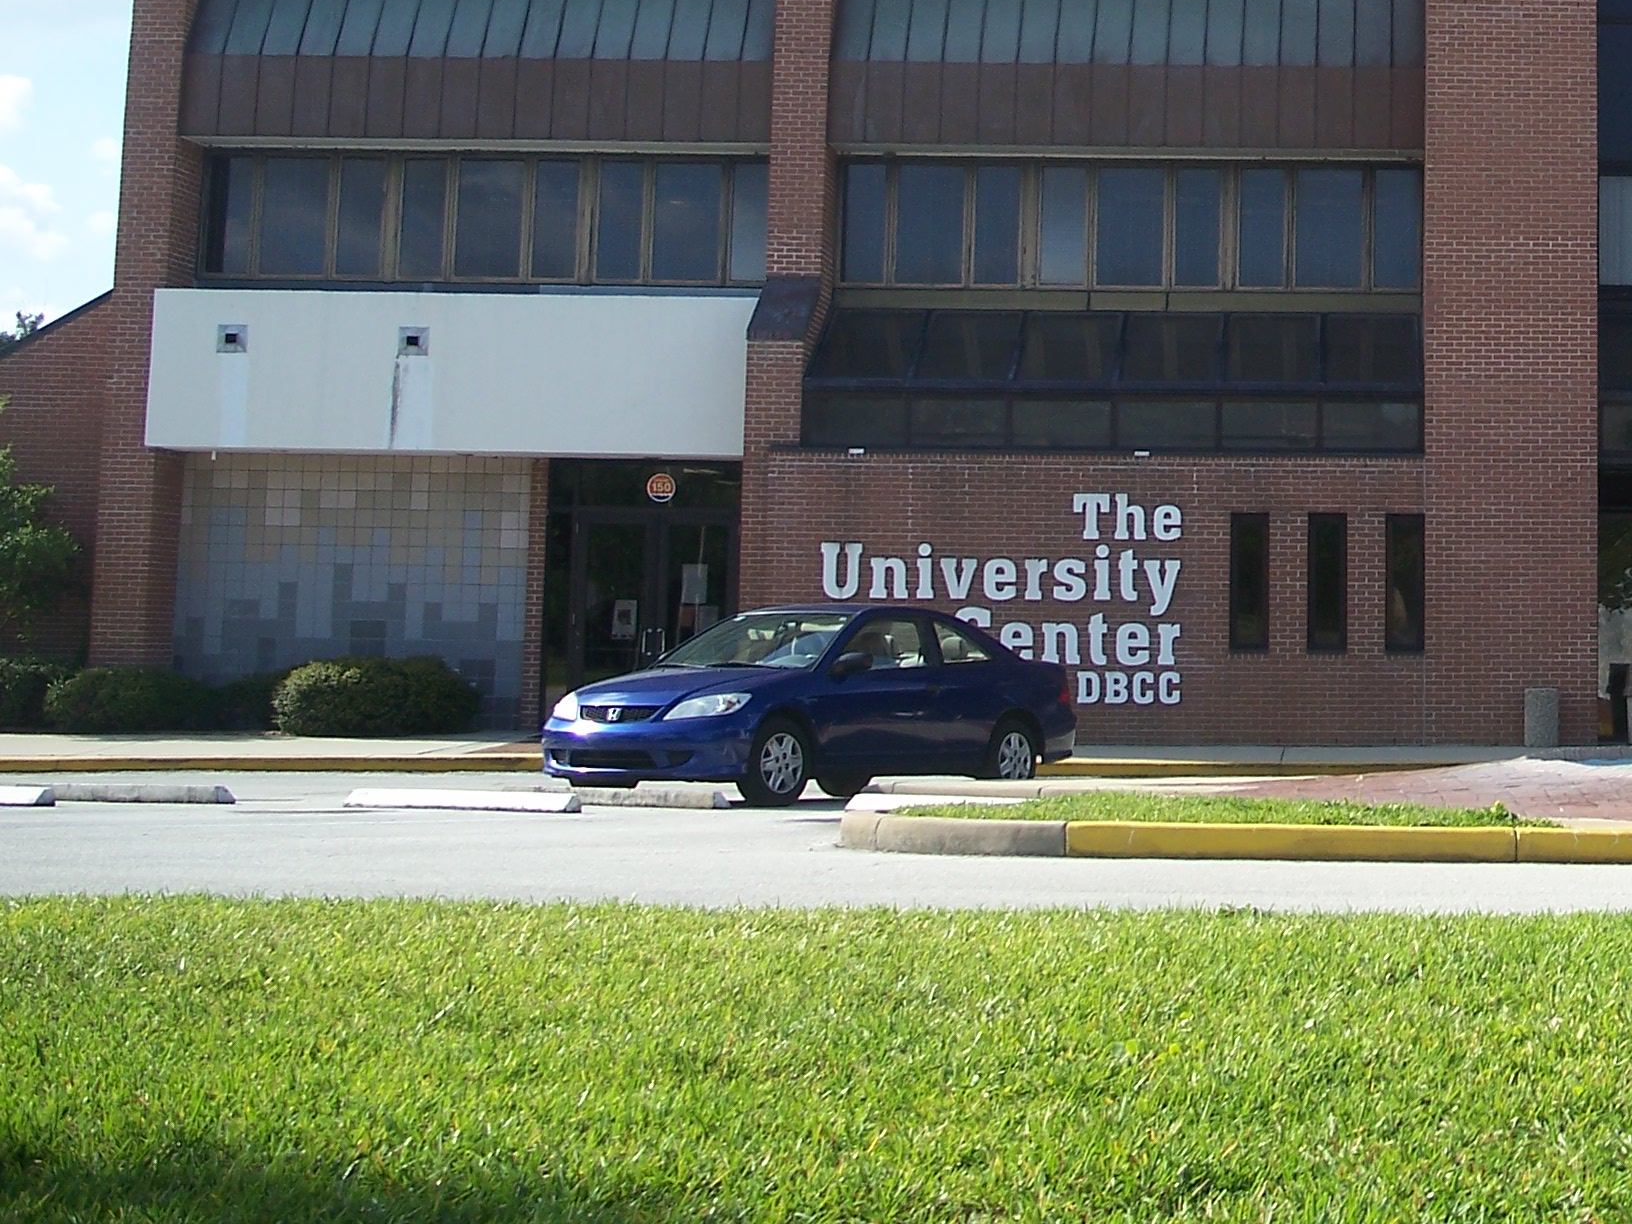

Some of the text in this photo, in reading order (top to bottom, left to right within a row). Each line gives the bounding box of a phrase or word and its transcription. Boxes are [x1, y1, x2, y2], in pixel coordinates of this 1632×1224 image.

[652, 482, 671, 492] 150
[1073, 492, 1183, 542] The
[820, 542, 1182, 617] University
[1077, 671, 1182, 705] DBCC
